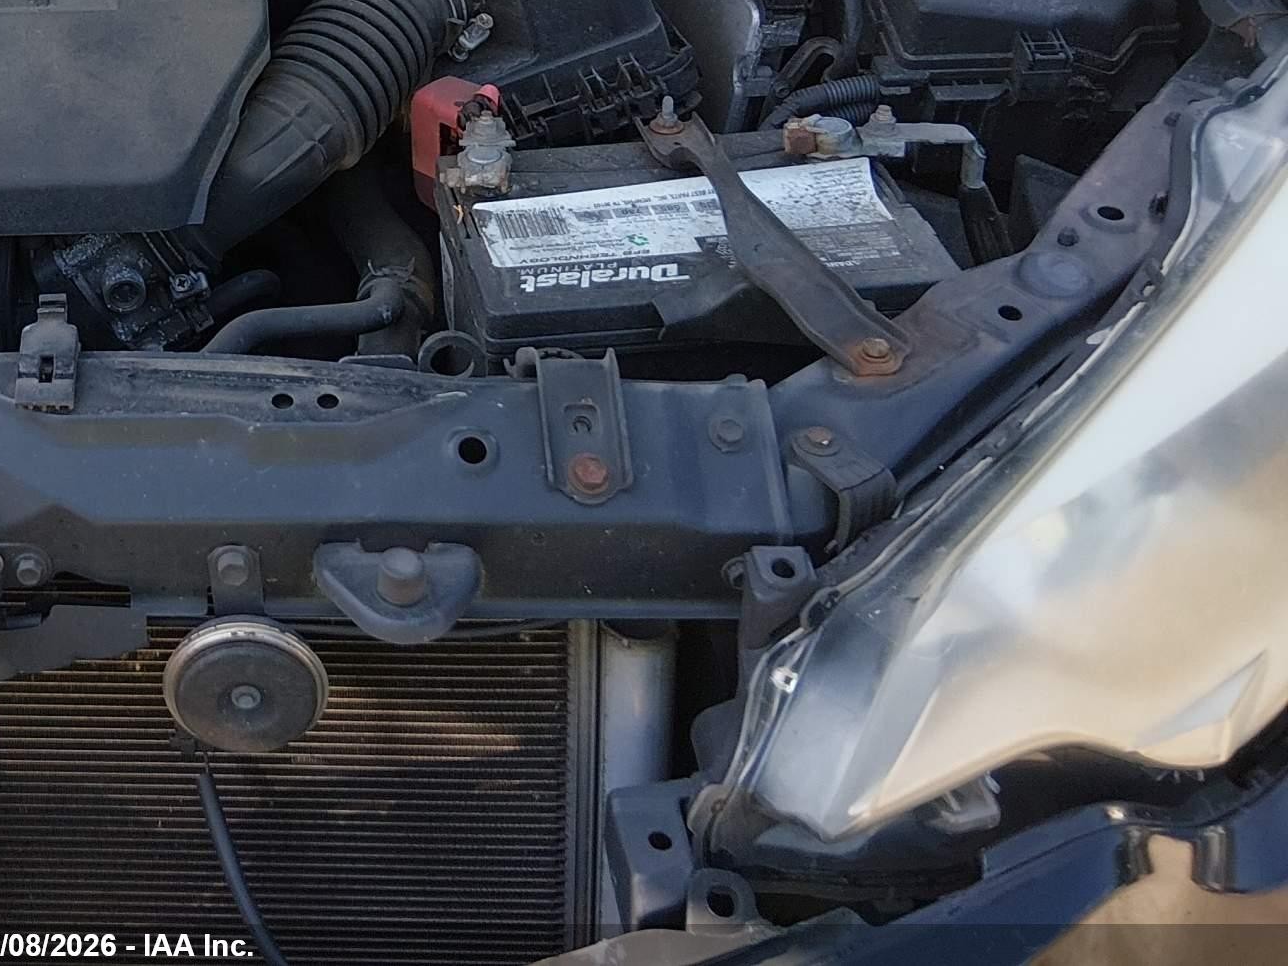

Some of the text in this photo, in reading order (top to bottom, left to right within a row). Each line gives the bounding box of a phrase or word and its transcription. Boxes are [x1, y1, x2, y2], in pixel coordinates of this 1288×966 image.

[519, 253, 617, 264] TECHNOLOGY
[520, 262, 618, 275] PLATINUM
[519, 262, 691, 293] Duralast
